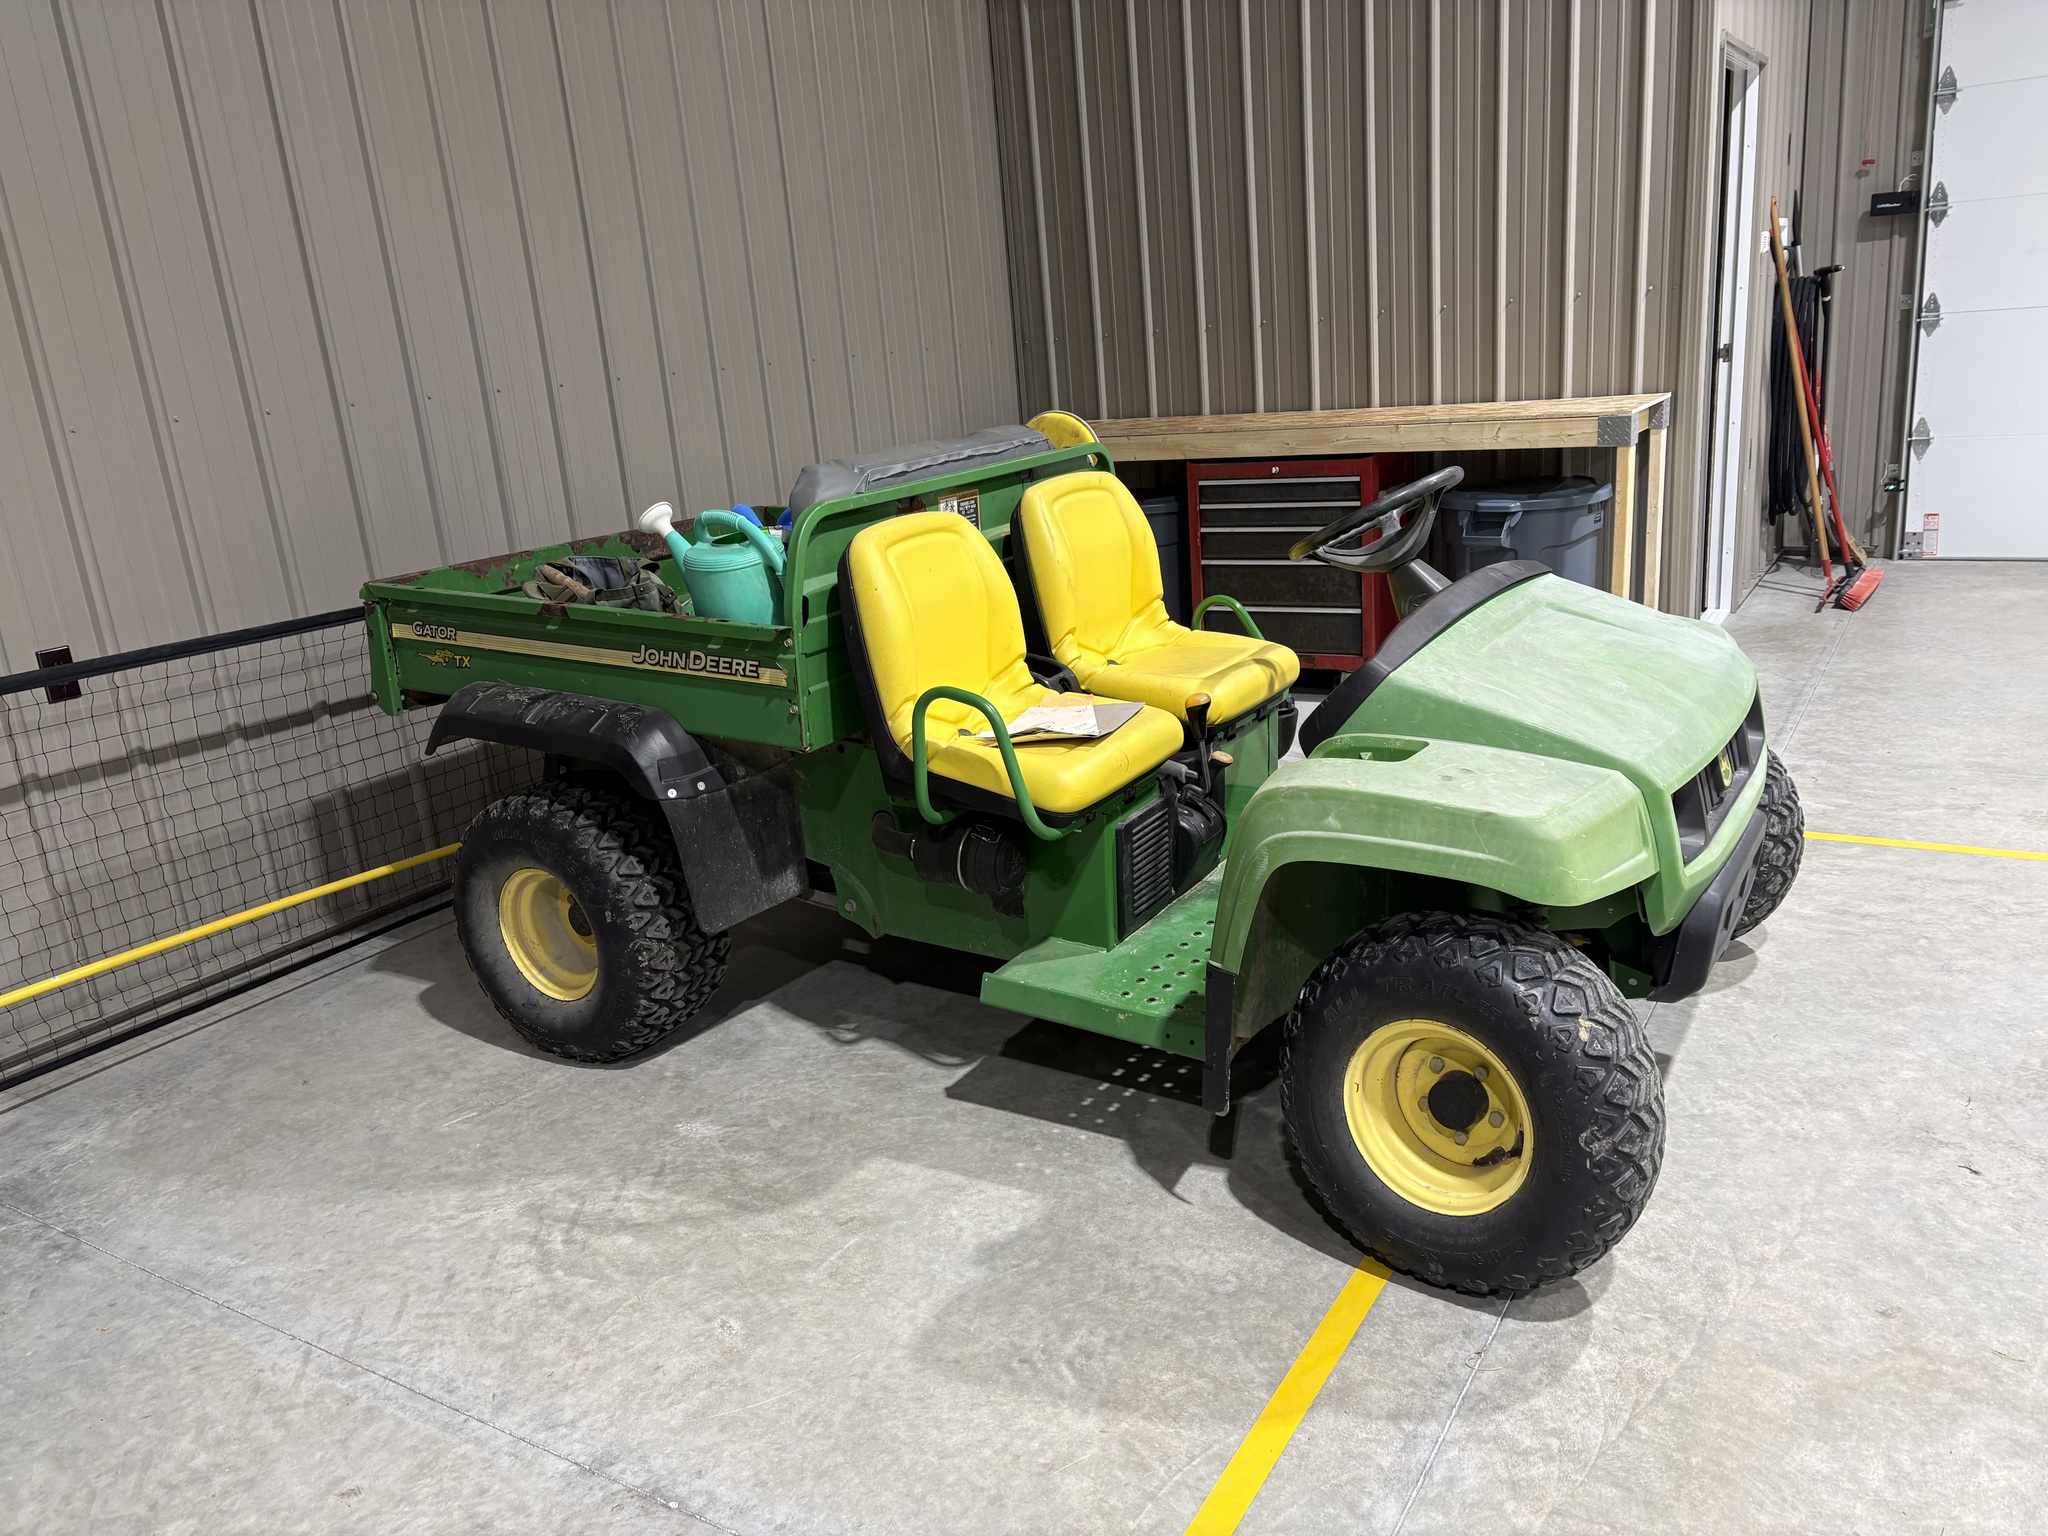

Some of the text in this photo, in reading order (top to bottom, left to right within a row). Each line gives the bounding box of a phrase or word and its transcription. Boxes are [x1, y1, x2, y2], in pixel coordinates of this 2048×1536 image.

[412, 620, 457, 641] GATOR
[453, 655, 471, 669] TX
[631, 644, 760, 679] JOHN DEERE
[1377, 975, 1467, 1003] TRAIL
